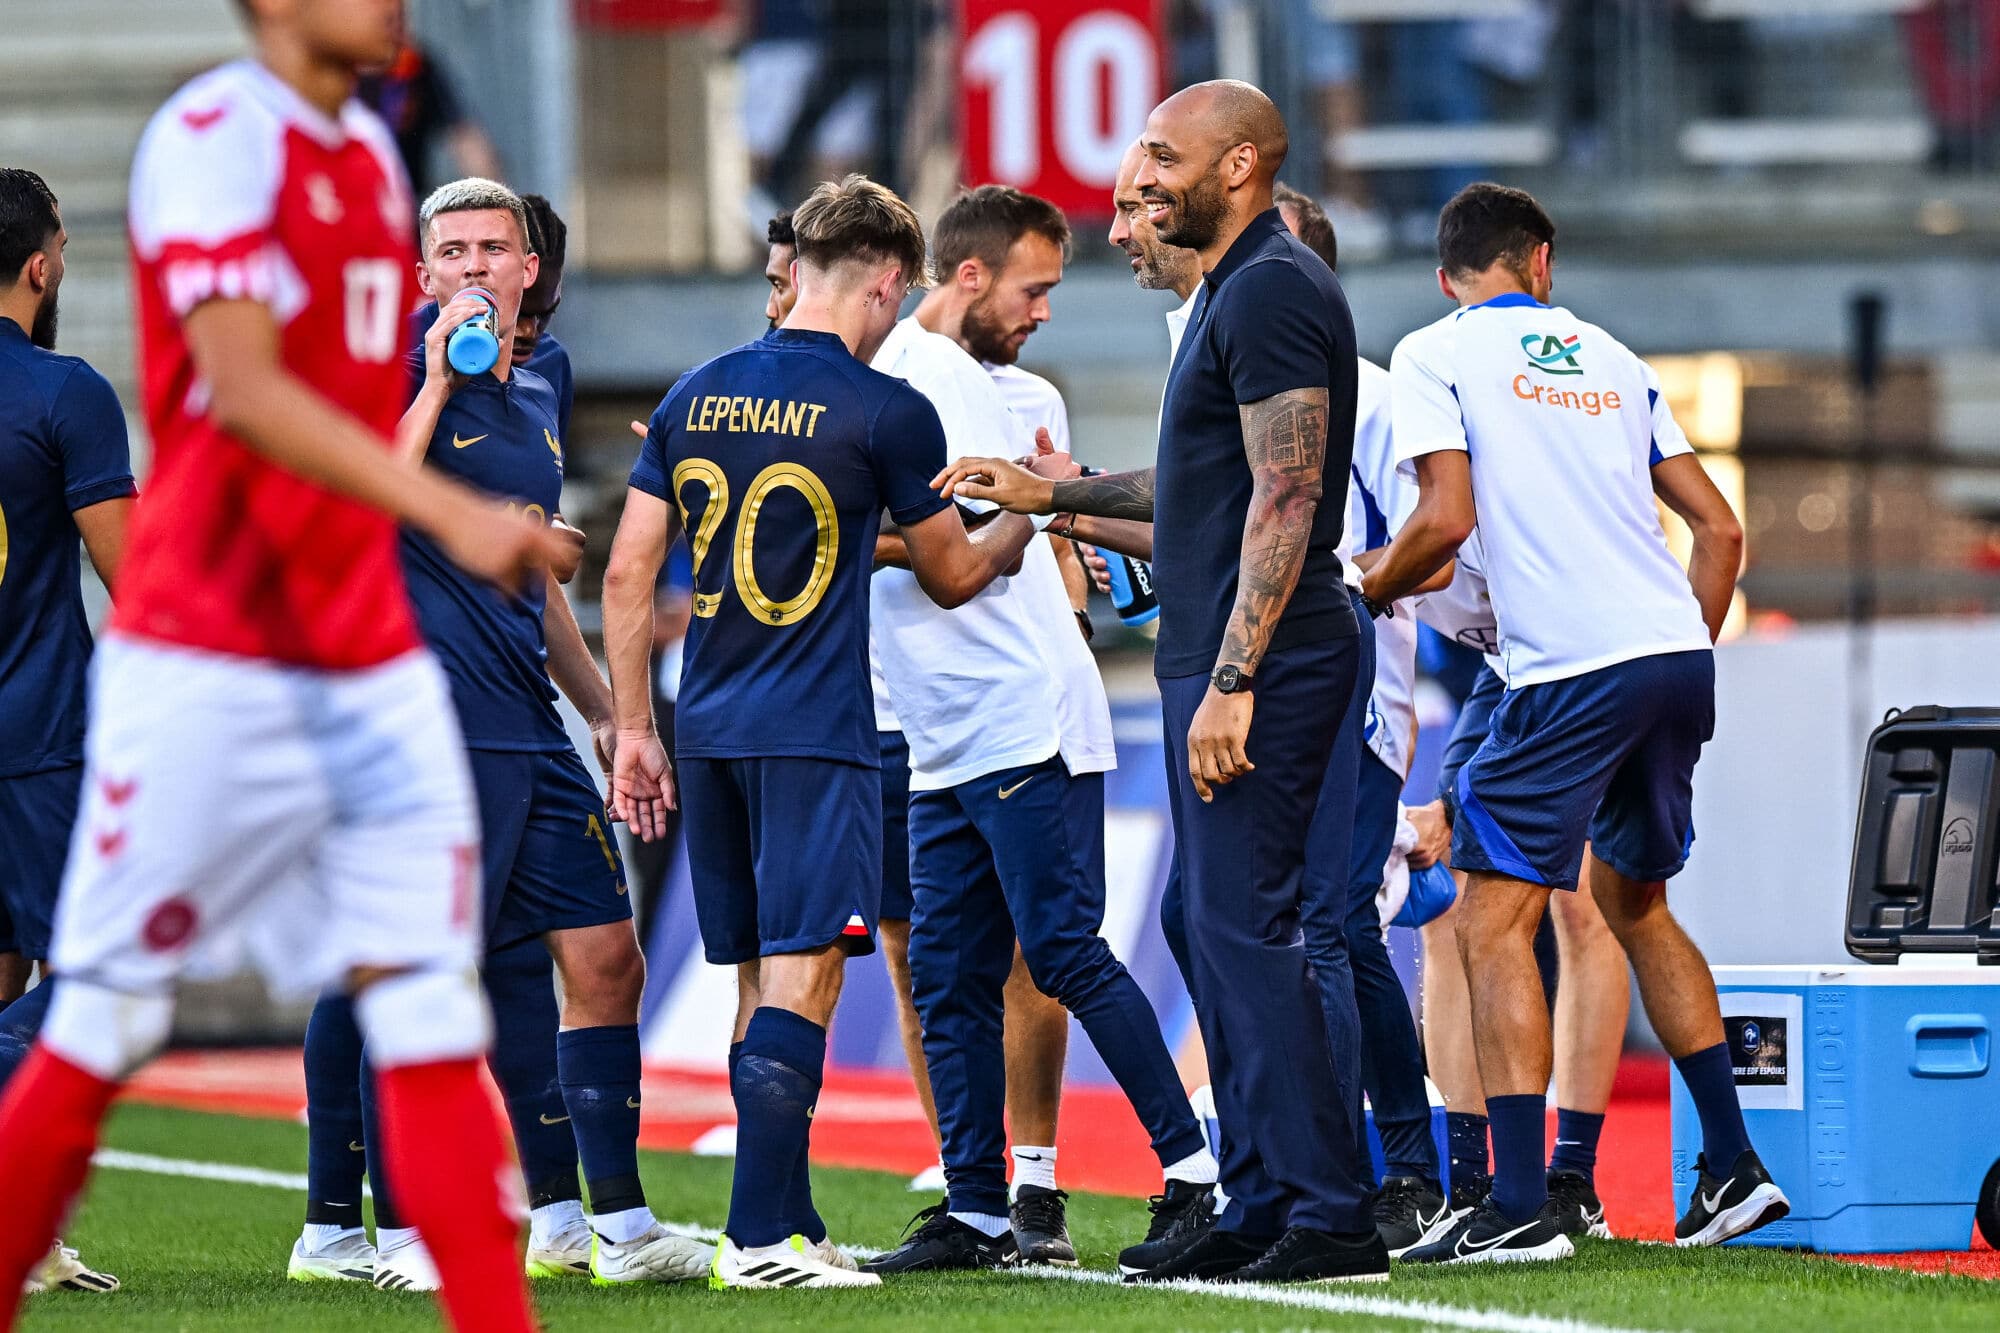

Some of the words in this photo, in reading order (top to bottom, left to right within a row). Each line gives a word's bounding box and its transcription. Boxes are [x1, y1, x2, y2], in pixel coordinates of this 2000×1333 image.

[962, 10, 1160, 189] 10
[1512, 374, 1621, 416] Orange
[686, 396, 827, 438] LEPENANT
[673, 458, 839, 626] 20
[1732, 1066, 1746, 1075] IERE
[1760, 1066, 1786, 1075] ESPOIRS
